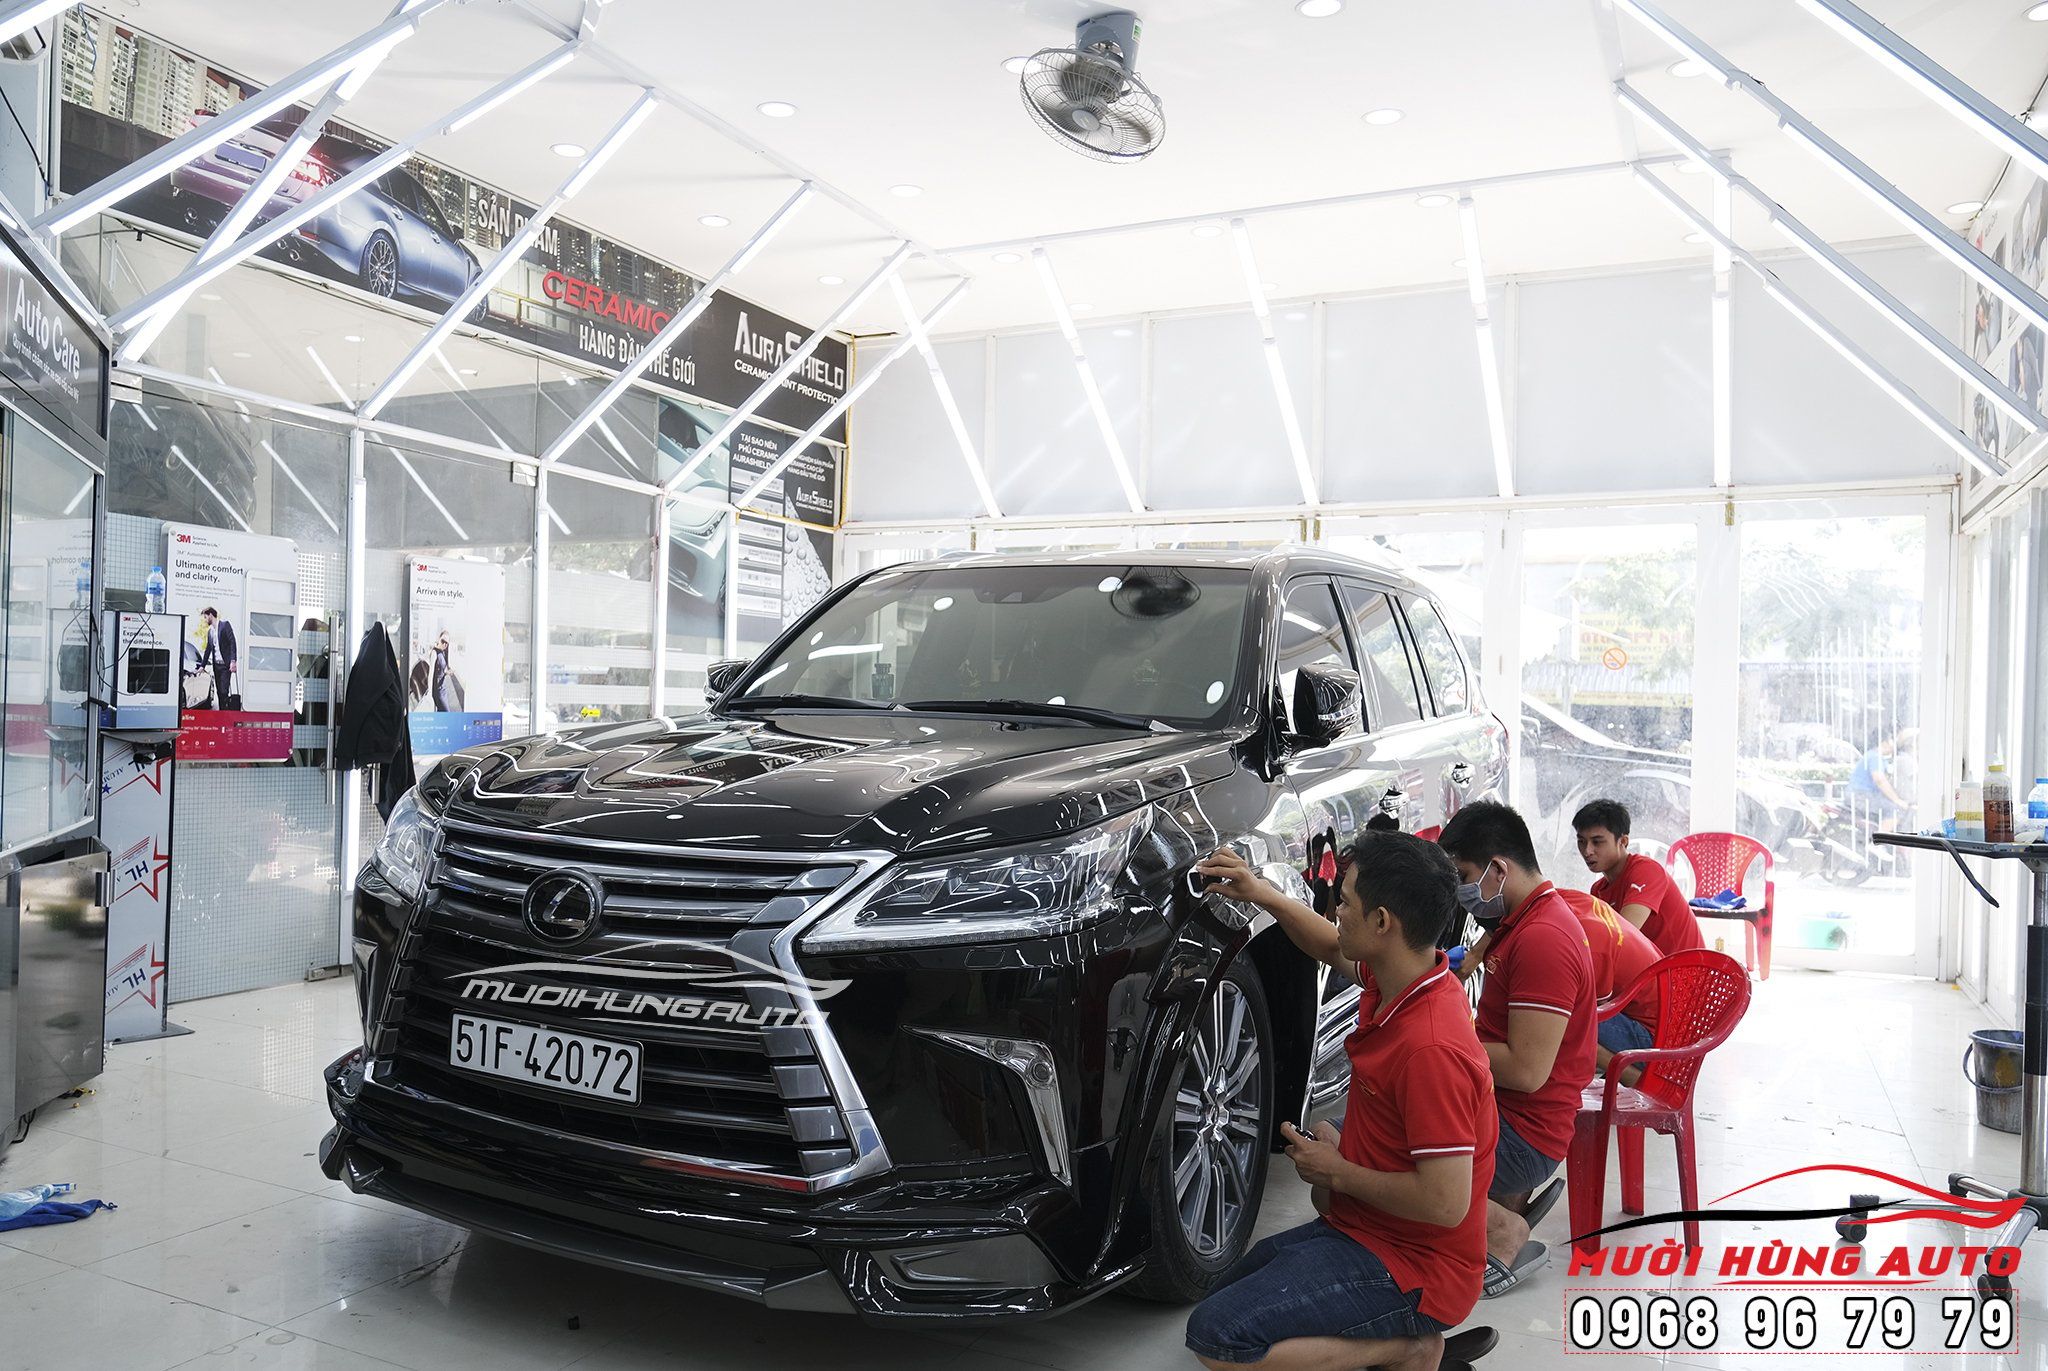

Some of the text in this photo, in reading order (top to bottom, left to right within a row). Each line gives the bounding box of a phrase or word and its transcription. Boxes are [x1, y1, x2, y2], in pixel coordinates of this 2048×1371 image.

[478, 195, 510, 238] SẢN
[14, 278, 80, 380] Auto Care
[579, 321, 616, 360] HÀNG
[672, 352, 695, 386] GIỚI
[797, 383, 841, 405] PROTECTIO
[751, 437, 764, 447] SAO
[176, 534, 191, 543] 3M
[175, 559, 244, 575] Ultimate comfort
[175, 571, 220, 583] and clarity.
[416, 586, 464, 599] Arrive in style.
[122, 630, 154, 639] Expeienc
[125, 860, 148, 882] HL
[122, 967, 146, 989] HL
[456, 1018, 634, 1098] 51F-420.72
